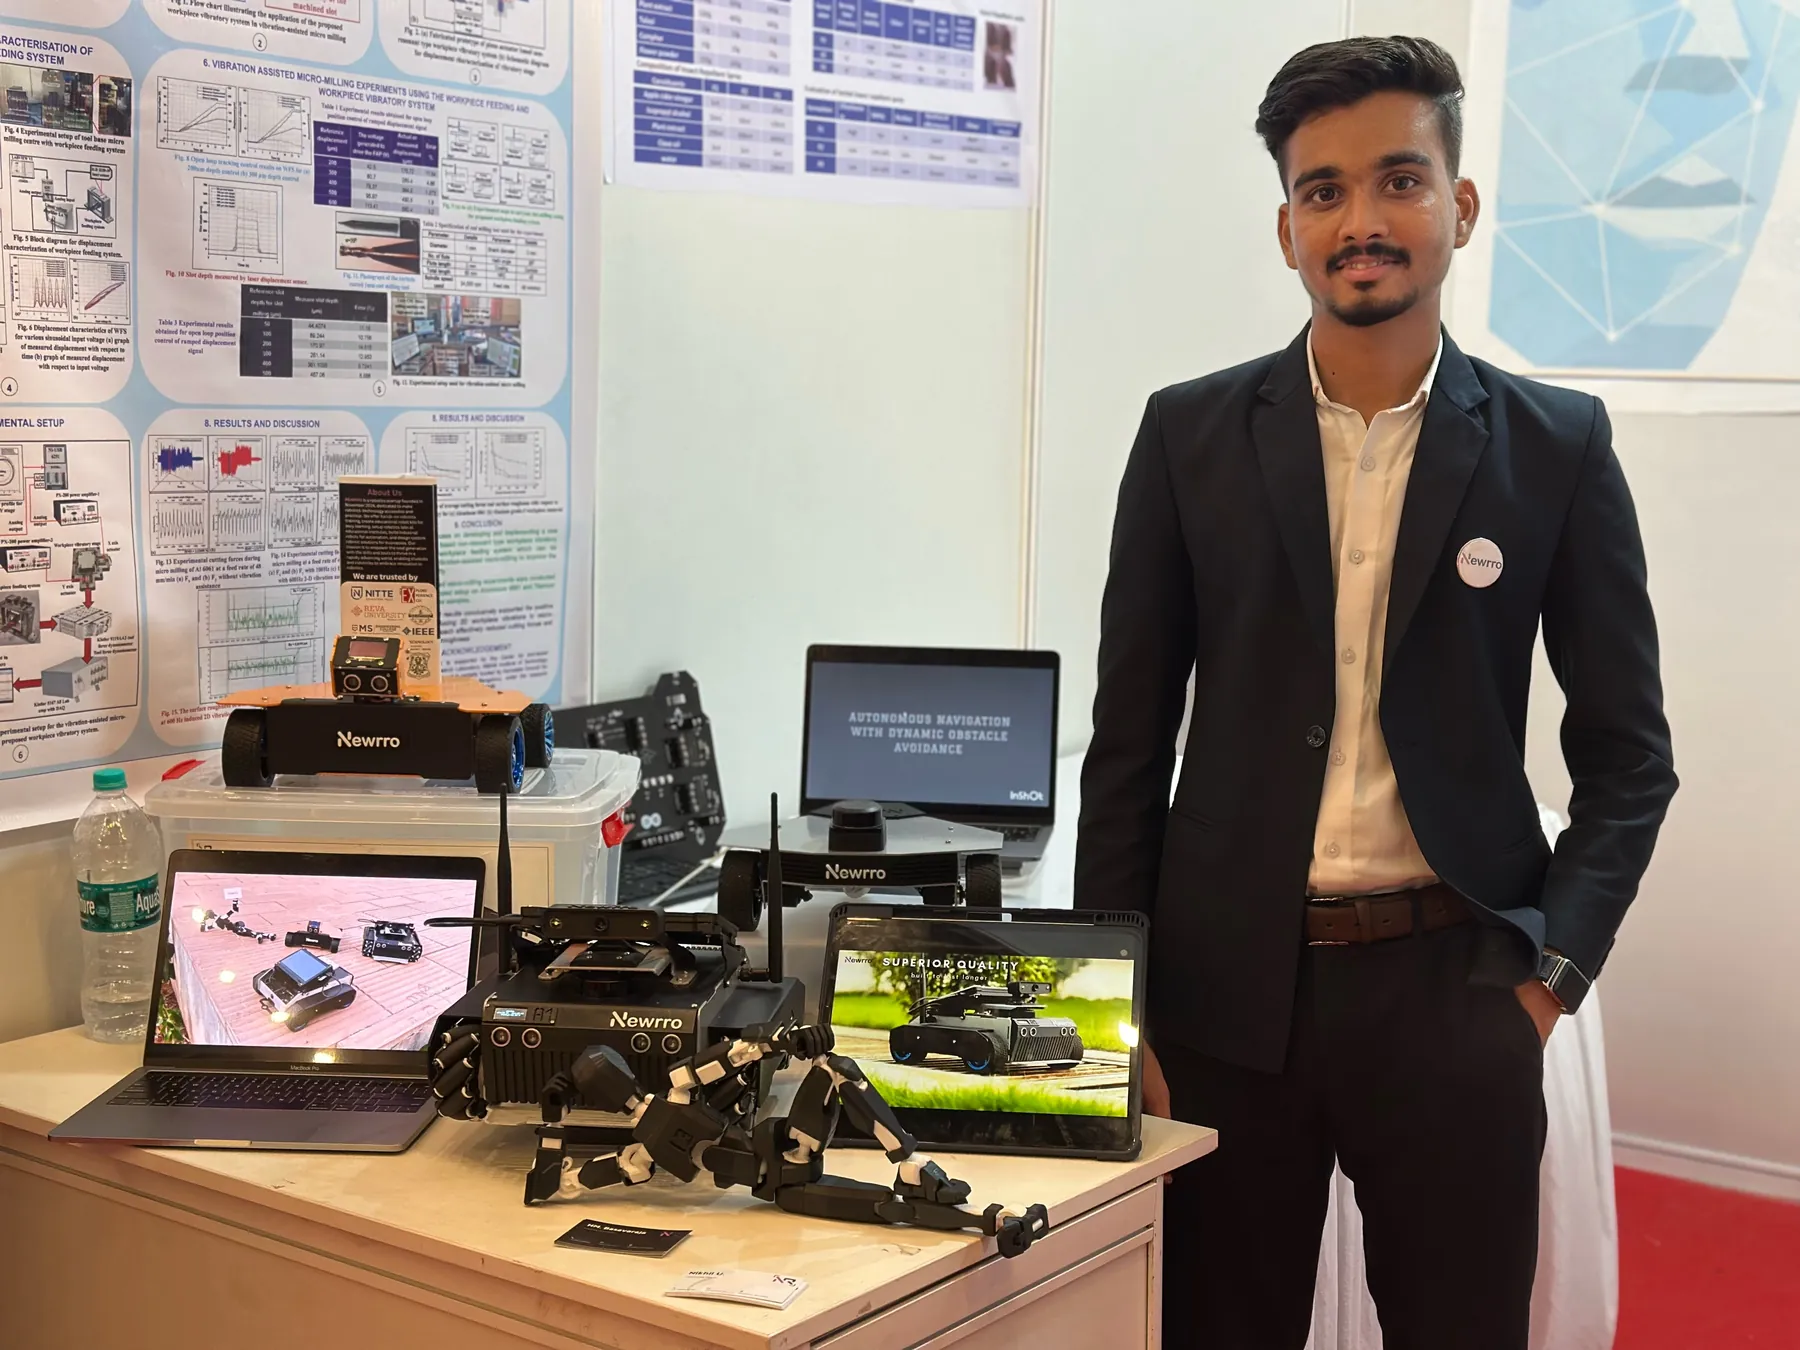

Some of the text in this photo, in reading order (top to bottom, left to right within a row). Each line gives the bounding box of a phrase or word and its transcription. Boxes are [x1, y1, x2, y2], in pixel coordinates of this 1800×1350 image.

[0, 36, 93, 56] RACTERISATION OF
[257, 40, 263, 48] 2
[0, 48, 65, 65] DING SYSTEM
[203, 59, 529, 113] 6. VIBRATION ASSISTED MICRO-MILLING EXPERIMENTS USING THE WORKPIECE FEEDING AND
[318, 88, 435, 111] WORKPIECE VIBRATORY SYSTEM
[20, 128, 58, 139] Experimental
[58, 132, 73, 141] setup
[74, 132, 80, 140] of
[81, 133, 93, 141] tool
[93, 135, 106, 143] base
[107, 137, 124, 145] micro
[3, 135, 22, 144] milling
[23, 138, 40, 146] centre
[54, 141, 83, 151] workpiece
[84, 144, 105, 153] feeding
[106, 147, 126, 155] system
[13, 235, 24, 243] Fig.
[46, 238, 68, 246] diagram
[78, 239, 113, 248] displacement
[17, 324, 28, 332] Fig.
[34, 325, 68, 333] Displacement
[69, 326, 106, 334] characteristics
[114, 338, 130, 346] graph
[53, 345, 87, 353] displacement
[6, 384, 12, 392] 4
[36, 418, 65, 428] SETUP
[204, 420, 320, 428] 8. RESULTS AND DISCUSSION
[439, 414, 469, 422] RESULTS
[485, 414, 525, 422] DISCUSSION
[368, 488, 403, 497] About Us
[1460, 552, 1502, 570] Newrro
[380, 573, 408, 581] trusted
[408, 573, 418, 582] by
[365, 589, 394, 598] NITTE
[401, 587, 416, 603] EX
[412, 627, 435, 636] IEEE
[848, 711, 1011, 728] AUTONOMOUS NAVIGATION
[32, 724, 46, 732] setup
[850, 726, 1008, 743] WITH DYNAMIC OBSTACLE
[1, 736, 27, 746] proposed
[28, 733, 55, 741] workpiece
[56, 729, 79, 738] vibratory
[337, 731, 400, 748] Newrro
[18, 751, 23, 759] 6
[893, 742, 963, 756] AVOIDANCE
[825, 863, 886, 880] Newrro
[882, 957, 1020, 971] SUPERIOR QUALITY
[961, 973, 989, 983] longer
[609, 1010, 683, 1031] Newrro
